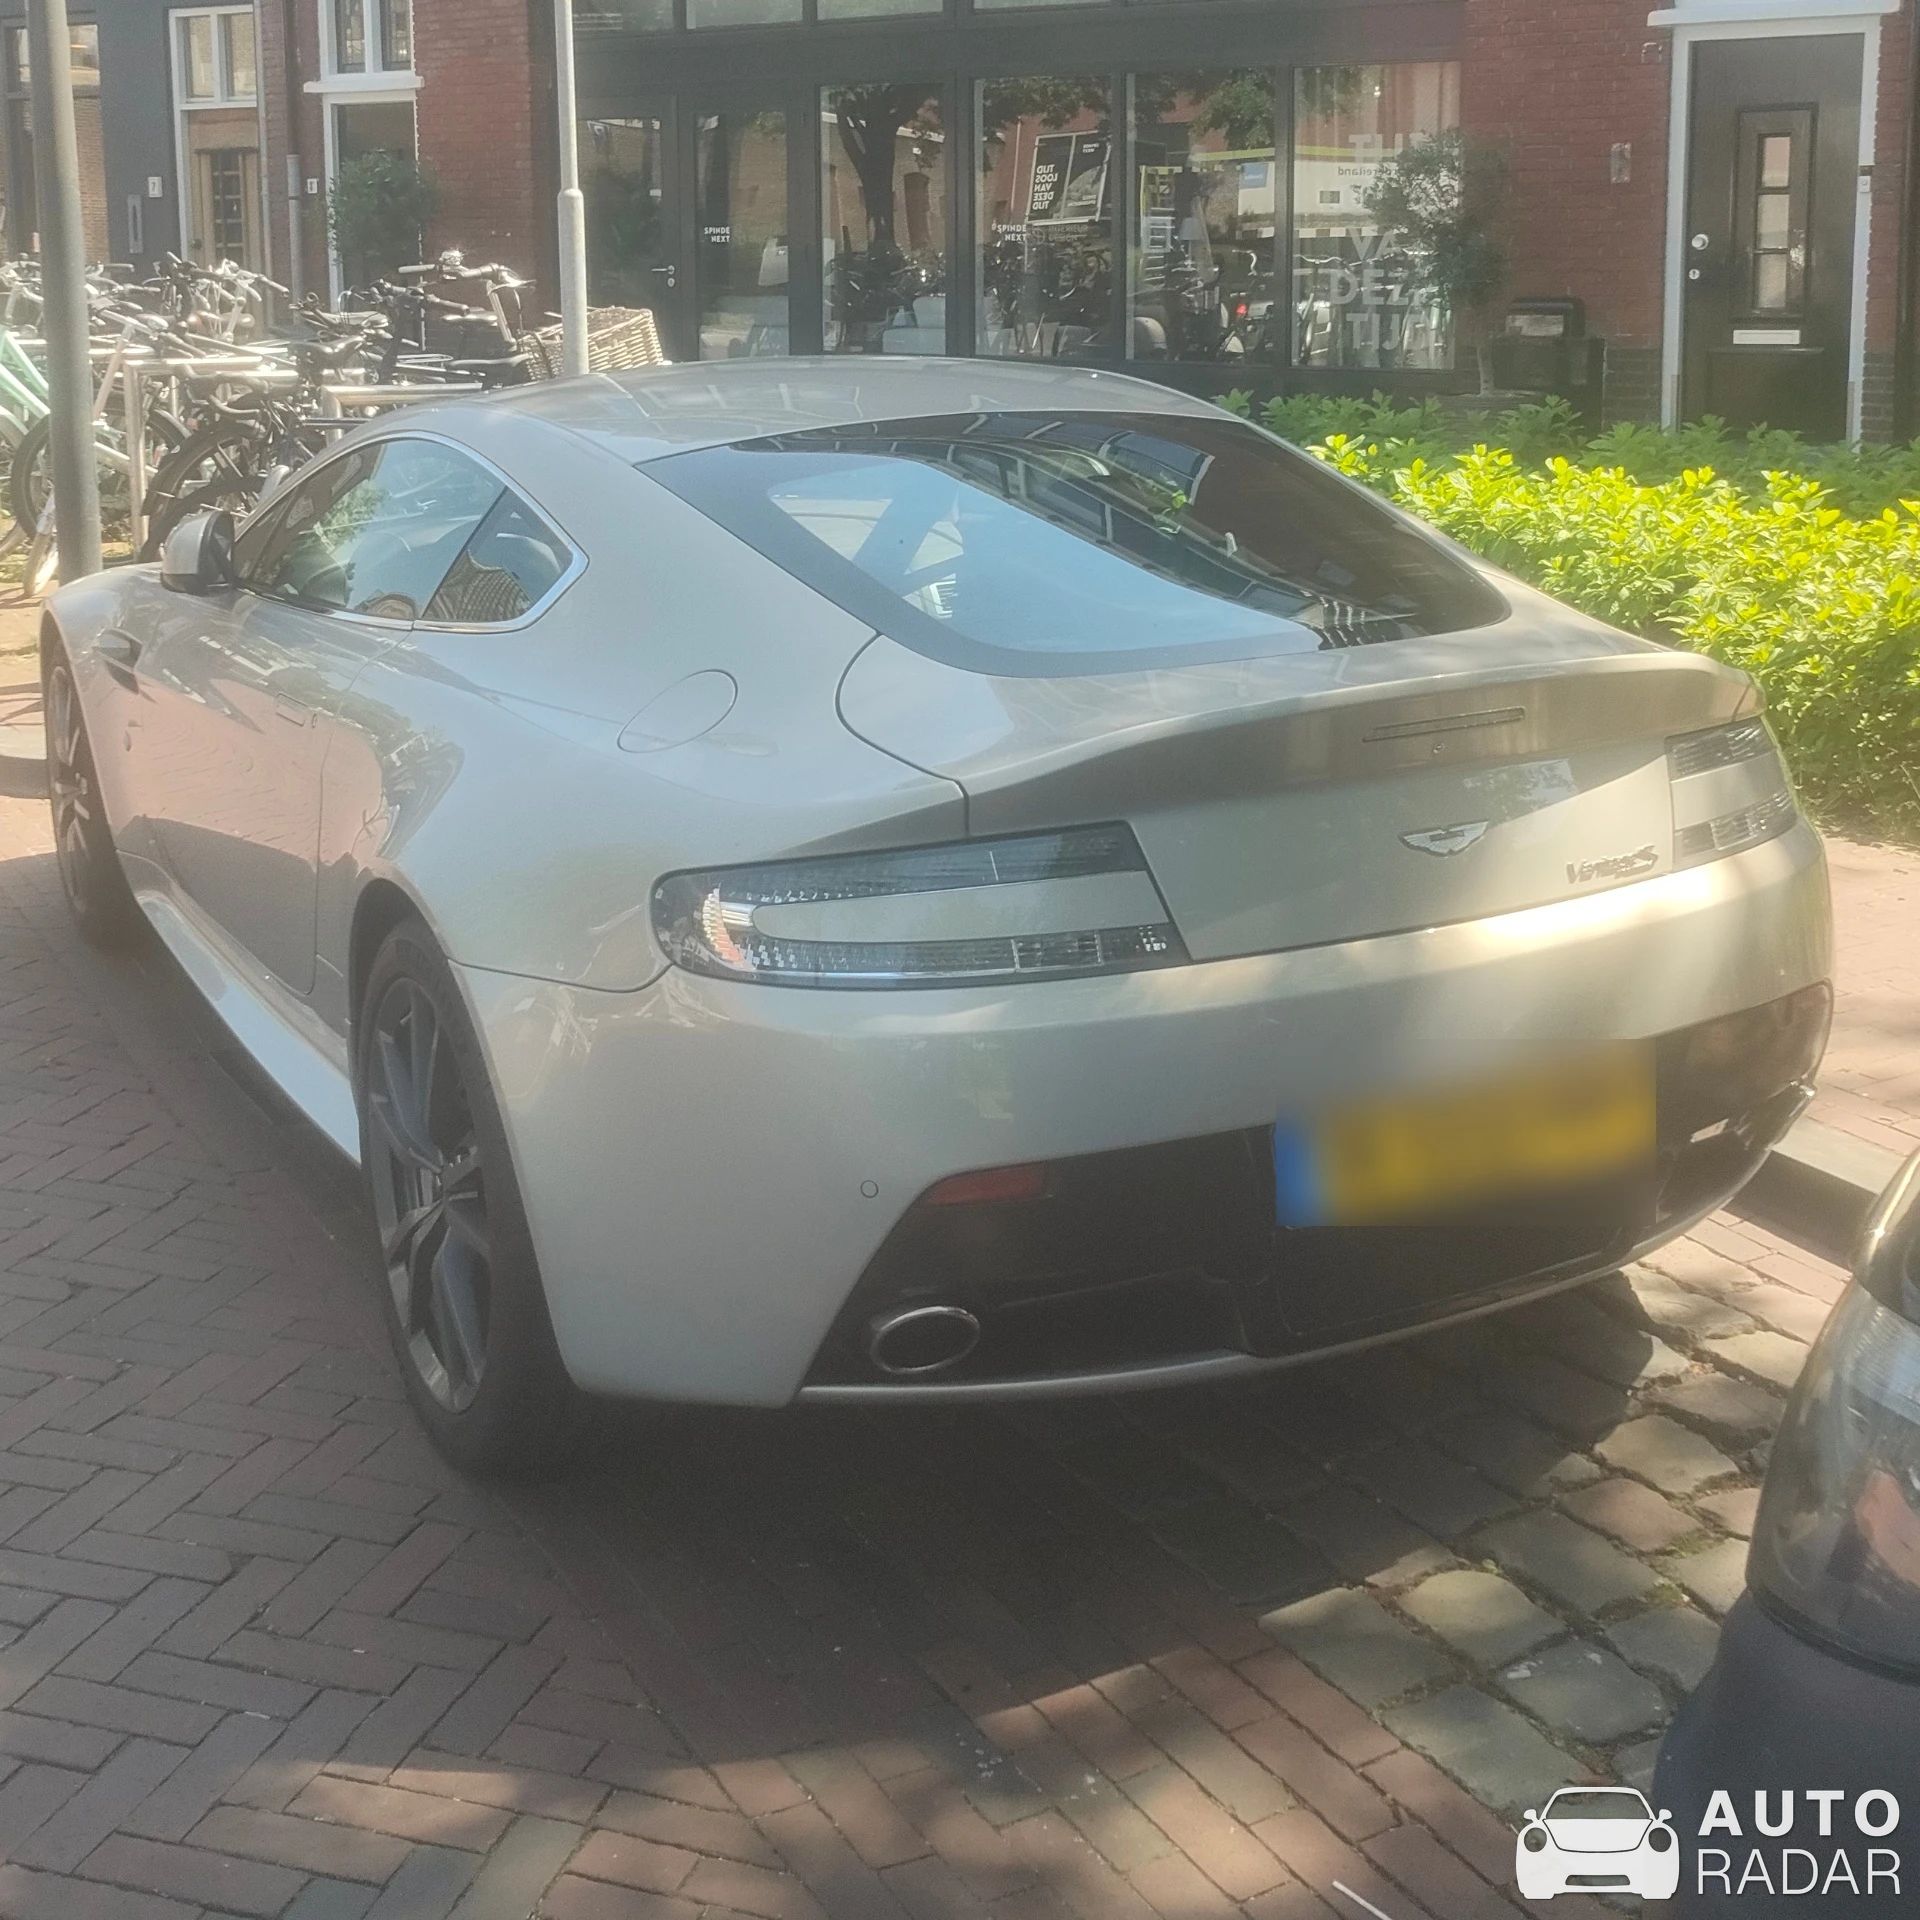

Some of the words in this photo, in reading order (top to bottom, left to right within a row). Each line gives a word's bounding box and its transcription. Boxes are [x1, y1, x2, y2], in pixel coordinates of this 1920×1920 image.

[704, 226, 730, 234] SPINDE
[997, 224, 1027, 233] SPINDE
[711, 235, 730, 243] NEXT
[1004, 233, 1027, 241] NEXT
[1347, 228, 1402, 261] VA
